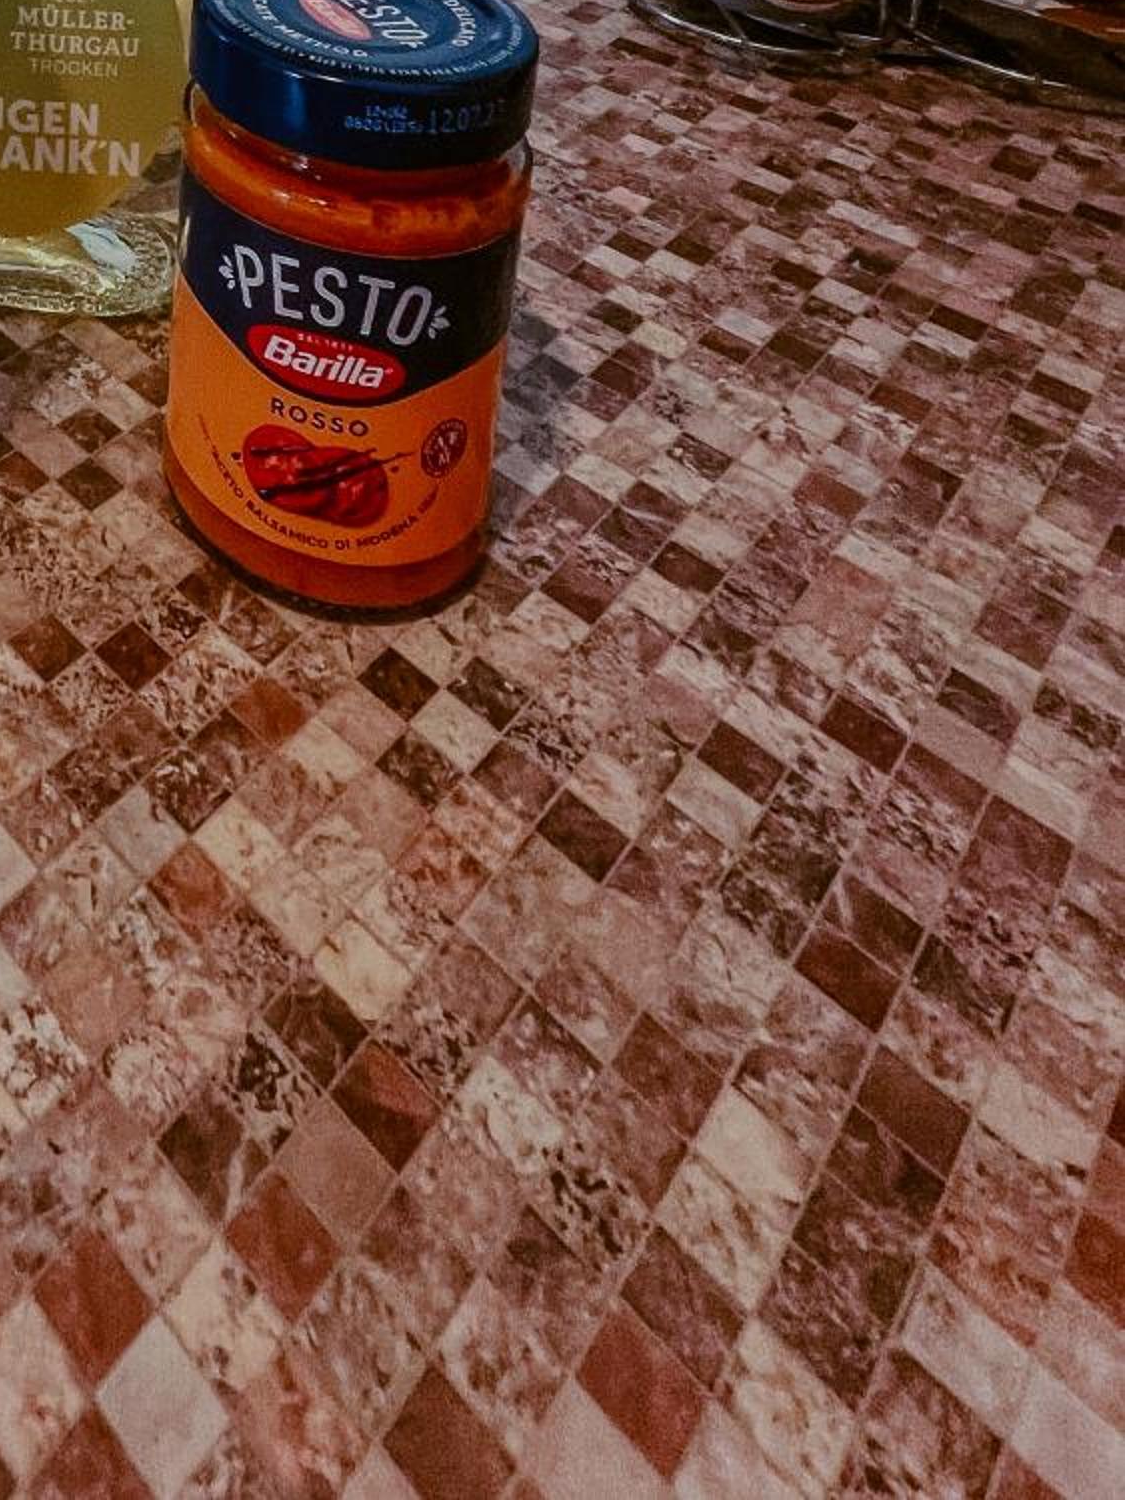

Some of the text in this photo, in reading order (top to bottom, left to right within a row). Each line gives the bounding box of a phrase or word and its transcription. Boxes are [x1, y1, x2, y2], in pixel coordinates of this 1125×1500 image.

[17, 4, 136, 33] MÜLLER-
[10, 31, 141, 58] THURGAU
[233, 244, 434, 347] PESTO
[262, 334, 386, 390] Barilla
[270, 396, 370, 438] ROSSO
